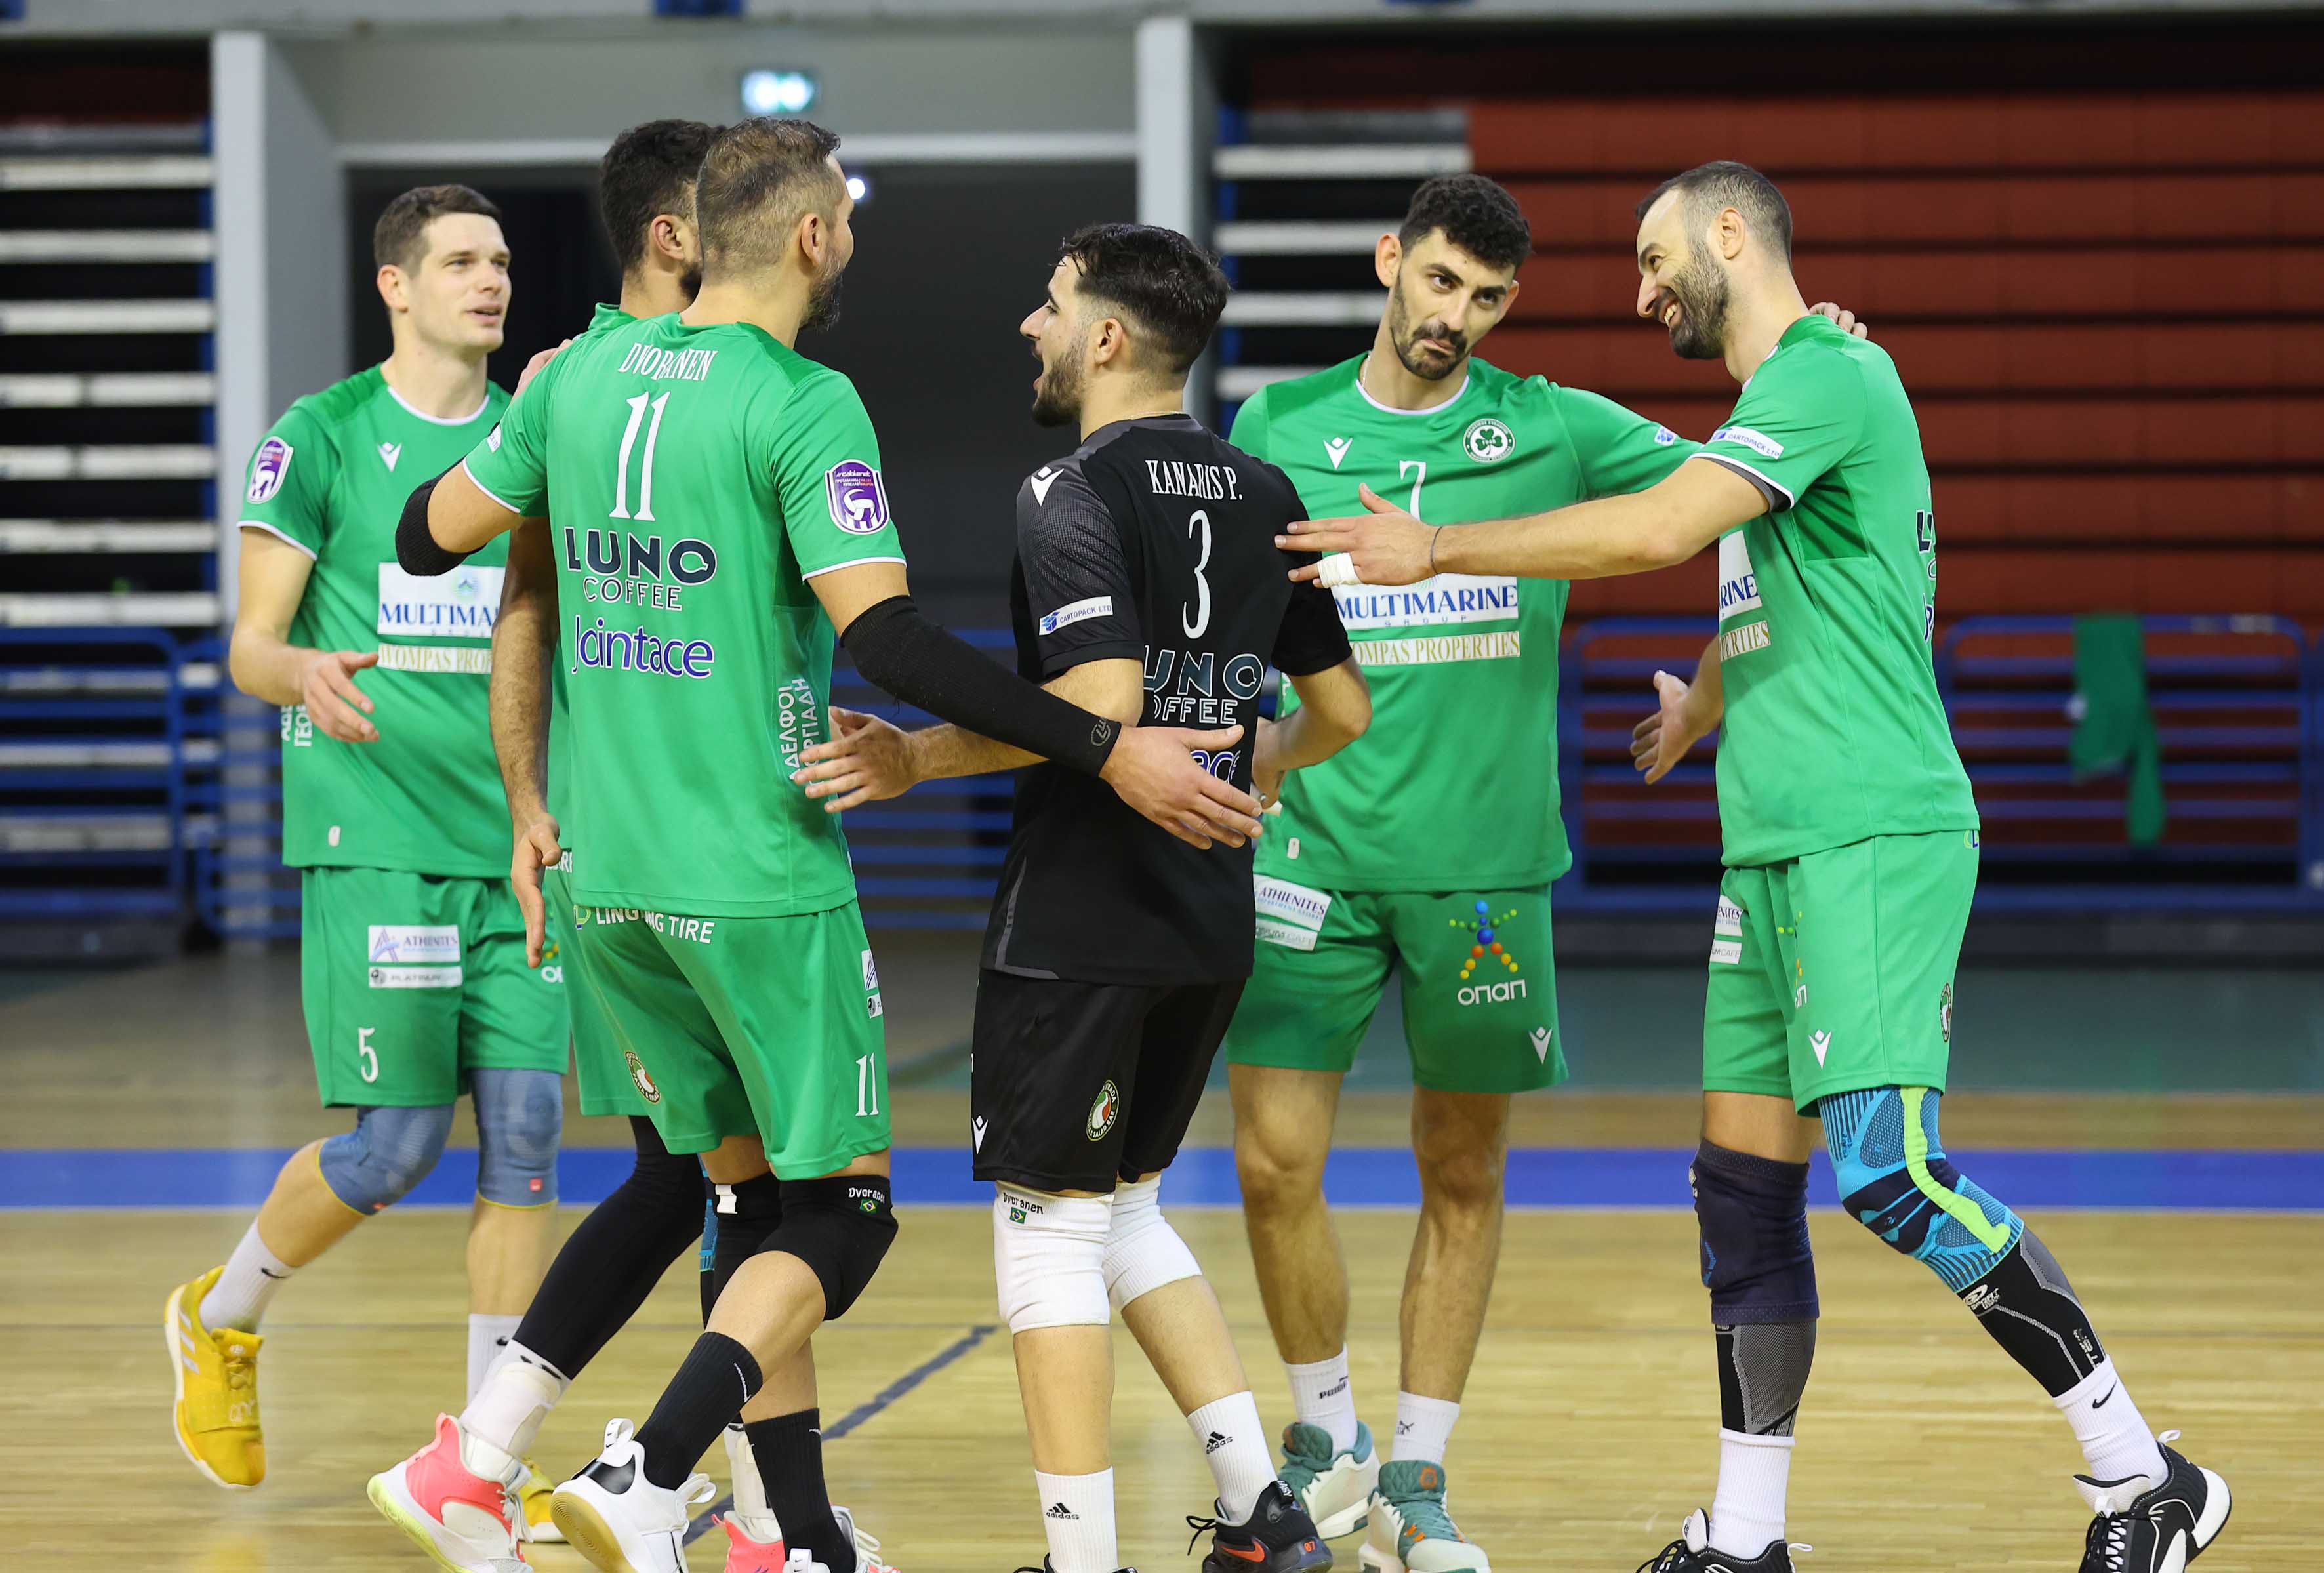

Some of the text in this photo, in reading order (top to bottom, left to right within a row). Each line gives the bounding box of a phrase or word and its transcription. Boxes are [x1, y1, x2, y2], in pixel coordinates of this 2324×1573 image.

[618, 342, 718, 381] DVORANEN
[609, 391, 671, 521] 11
[1728, 433, 1767, 452] CARTOPACK
[1145, 460, 1243, 500] KANARIS P.
[1399, 460, 1427, 521] 7
[564, 526, 718, 586] LUNO
[1183, 509, 1212, 639] 3
[583, 576, 682, 611] COFFEE
[1335, 585, 1518, 619] MULTIMARINE
[1059, 607, 1096, 624] CARTOPACK
[572, 614, 714, 680] Jointace
[1415, 632, 1520, 663] PROPERTIES
[1260, 887, 1325, 915] ATHIENITES
[668, 916, 716, 944] TIRE
[358, 1027, 379, 1084] 5
[855, 1052, 879, 1116] 11
[1003, 1191, 1044, 1215] Dvoranen
[1205, 1435, 1234, 1454] adidas
[1046, 1511, 1080, 1521] adidas
